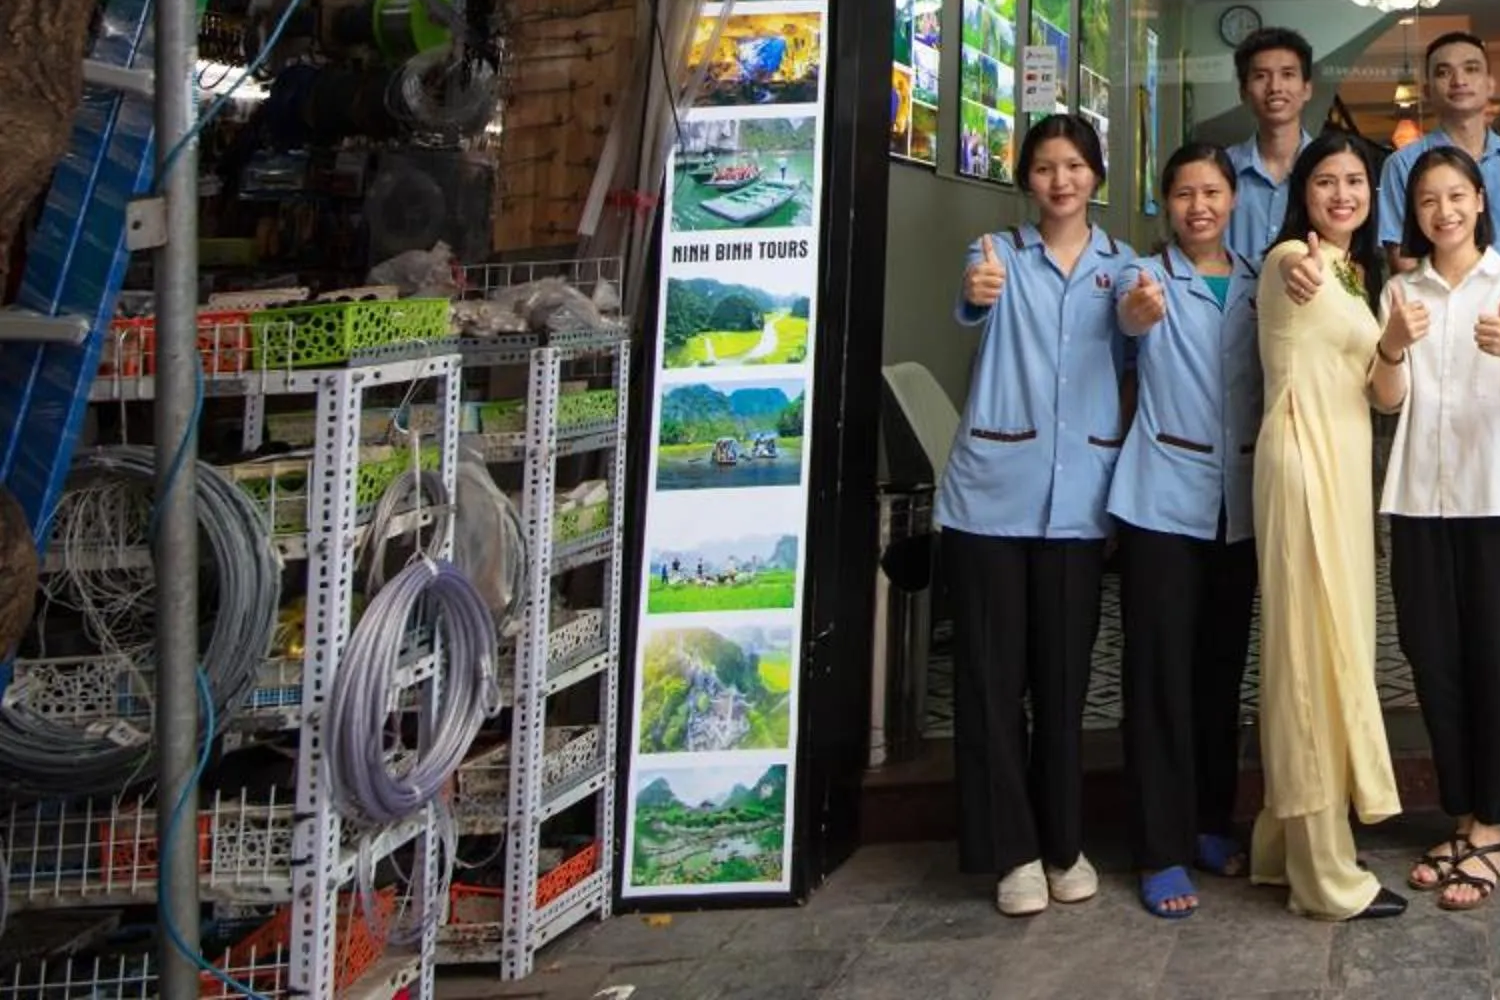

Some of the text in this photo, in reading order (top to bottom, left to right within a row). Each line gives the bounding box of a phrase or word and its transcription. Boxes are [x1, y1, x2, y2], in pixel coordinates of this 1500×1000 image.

[672, 239, 809, 263] NINH BINH TOURS
